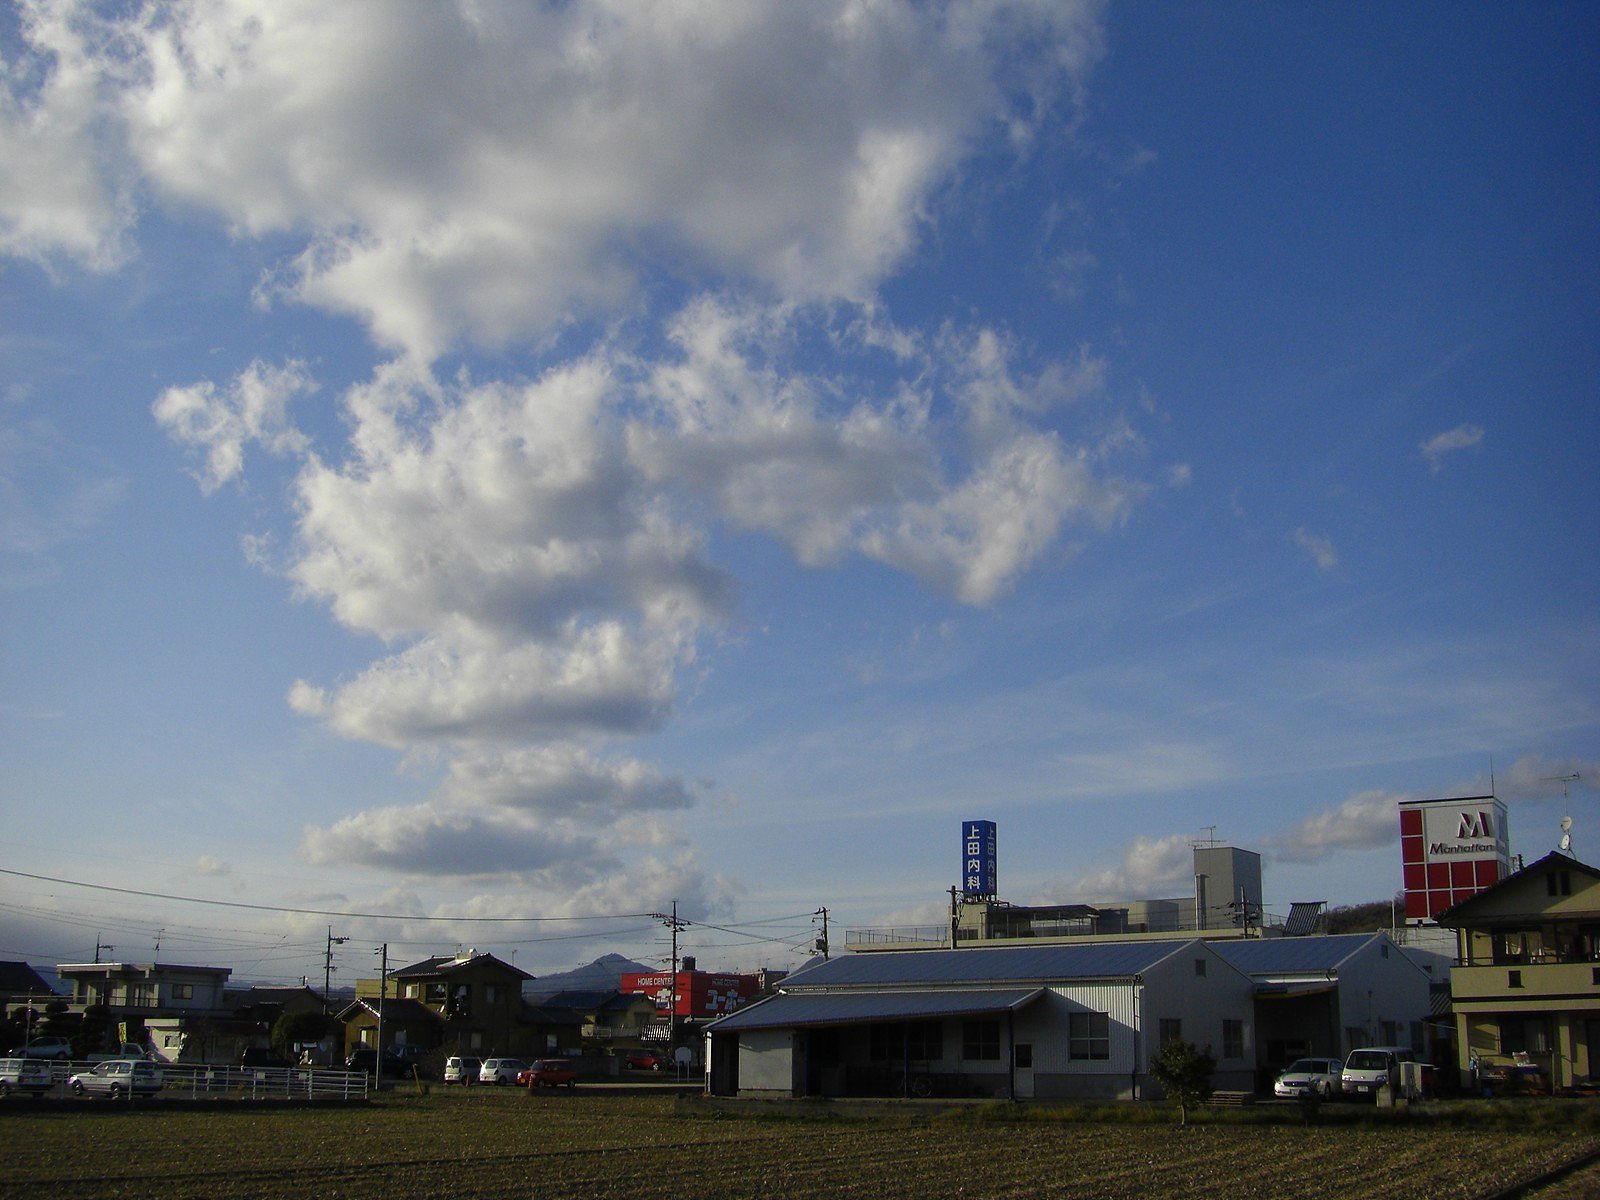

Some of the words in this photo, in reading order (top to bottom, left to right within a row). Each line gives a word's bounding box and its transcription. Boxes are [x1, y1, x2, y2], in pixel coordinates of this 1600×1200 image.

[1429, 842, 1494, 855] Manhattan
[967, 825, 980, 890] 上田内科
[987, 825, 995, 890] 上田内科
[637, 977, 653, 986] HOME
[712, 977, 723, 985] HOME
